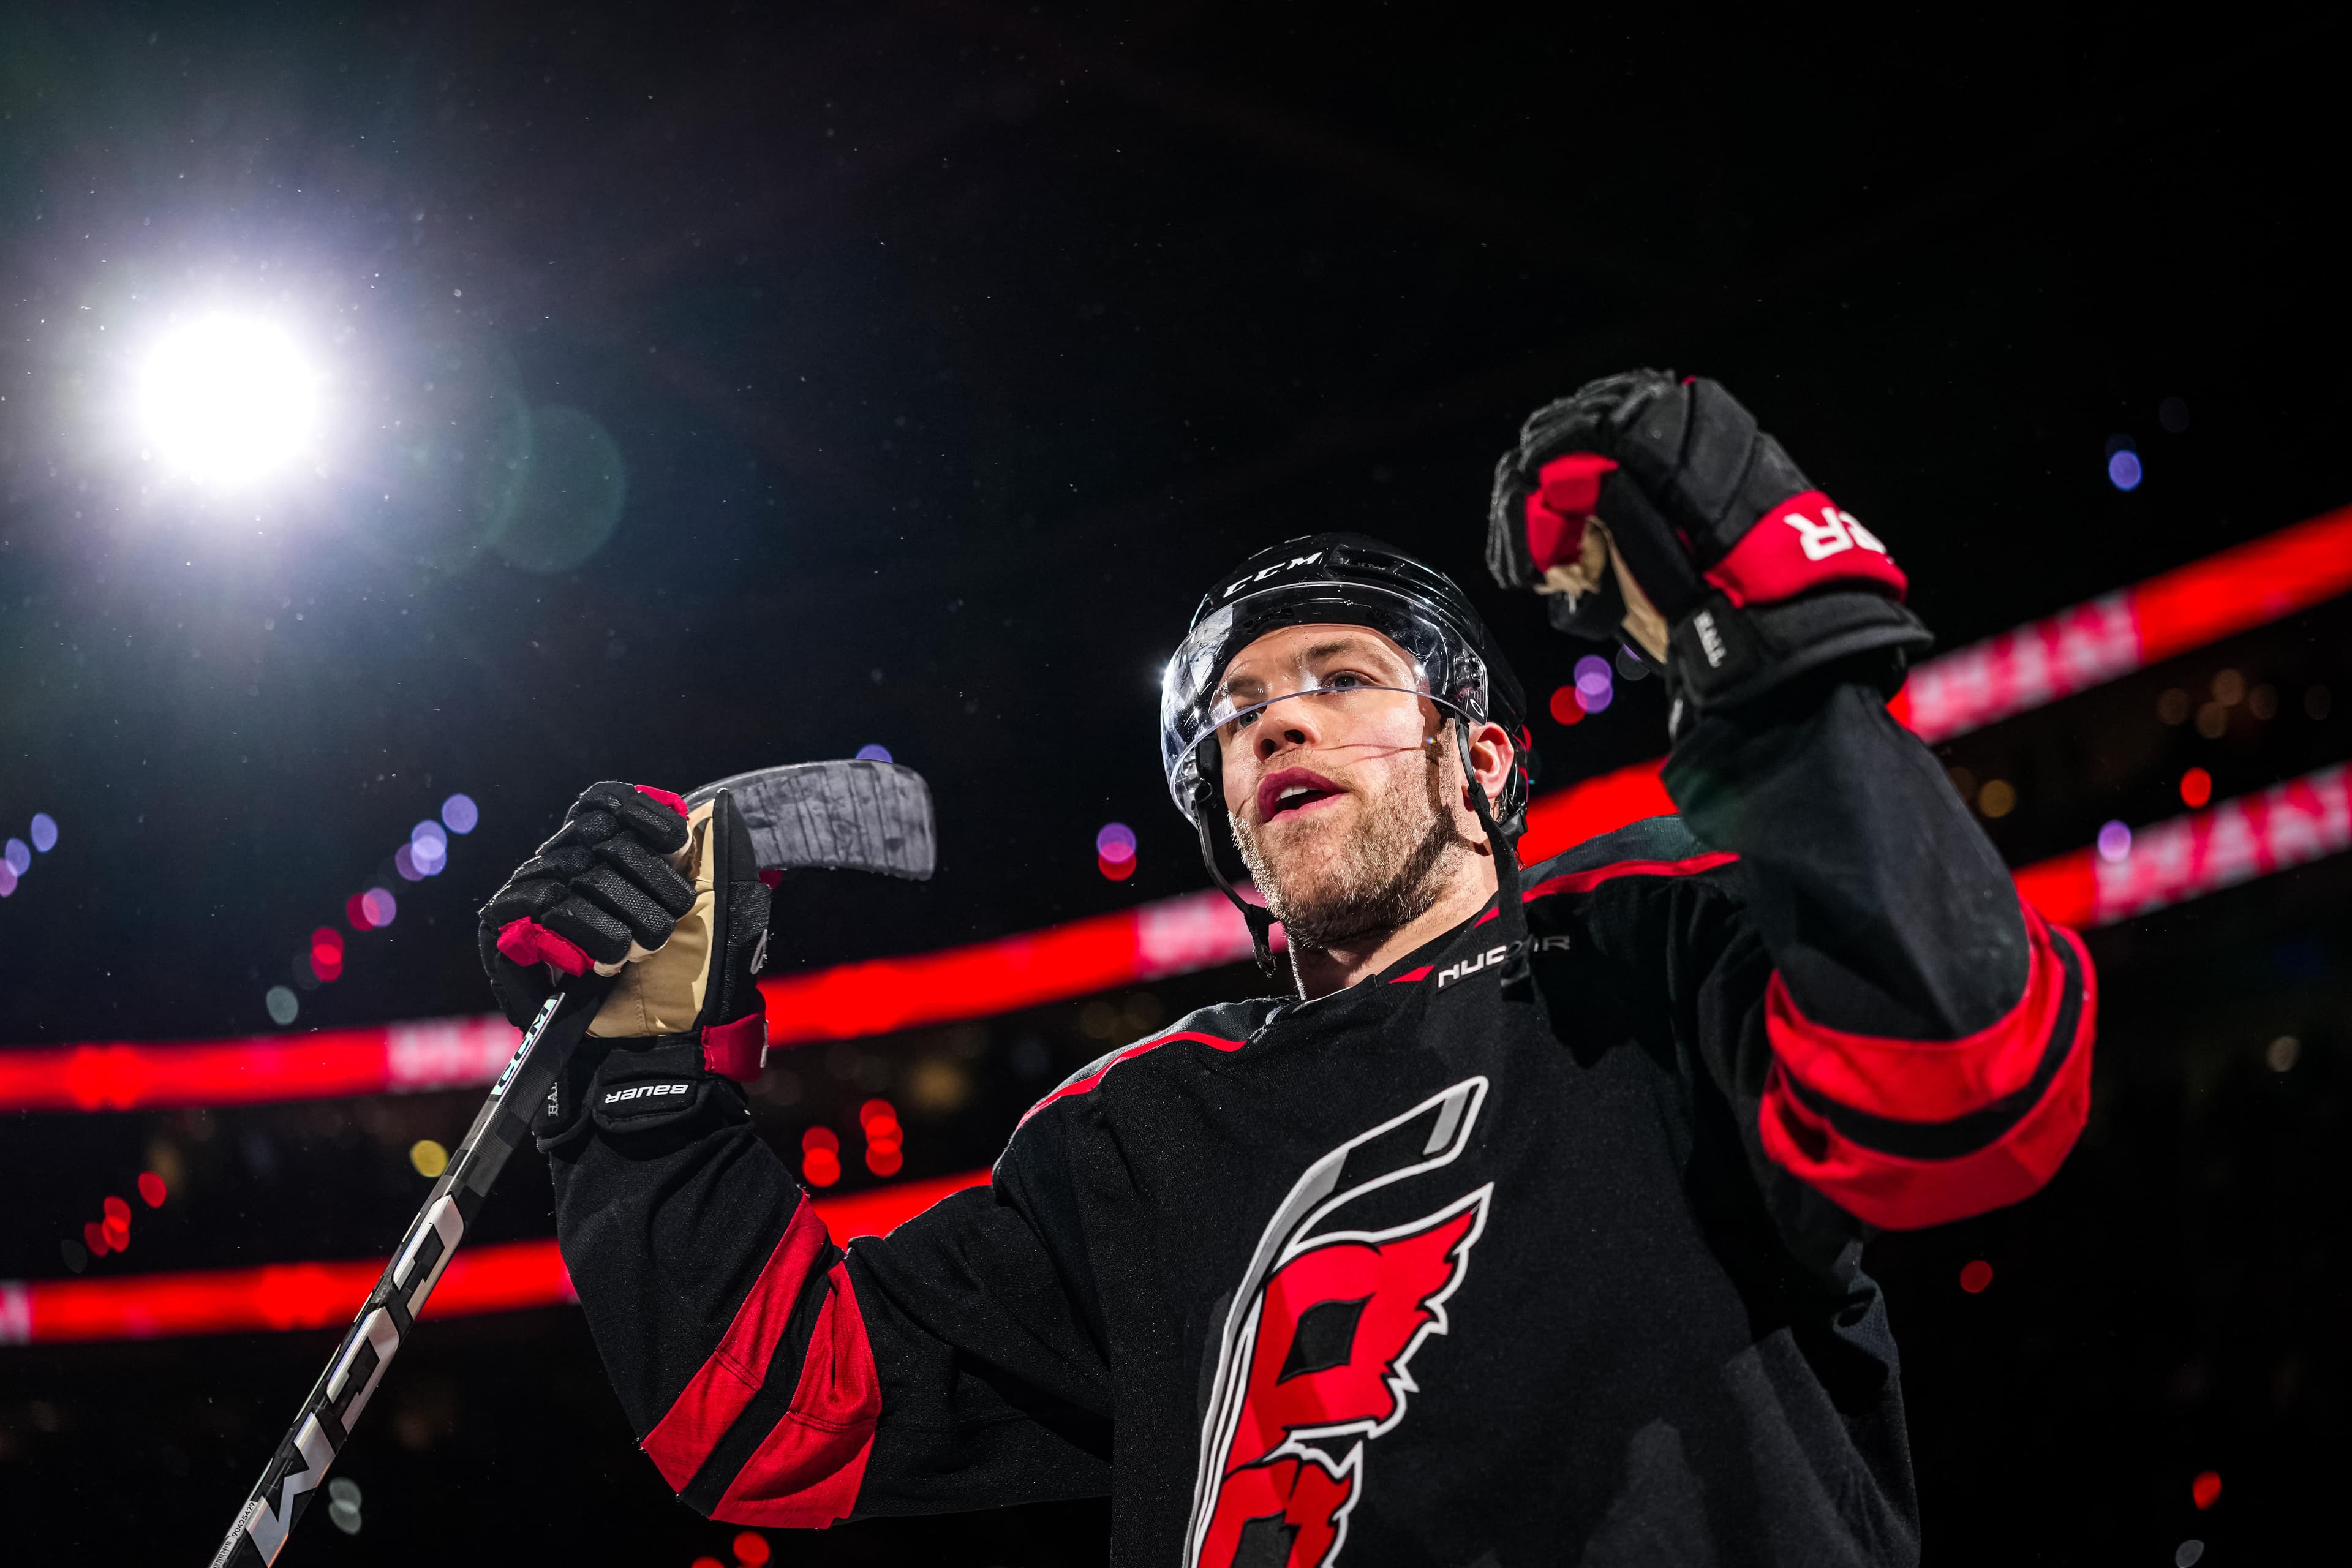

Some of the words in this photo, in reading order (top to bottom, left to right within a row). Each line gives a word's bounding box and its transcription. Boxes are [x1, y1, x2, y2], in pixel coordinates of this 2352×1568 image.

[1223, 551, 1323, 598] CCM
[1438, 935, 1571, 989] NUCR
[497, 1006, 549, 1088] CCM
[604, 1084, 689, 1104] BAUER
[246, 1194, 465, 1568] CCM
[232, 1501, 256, 1538] 90425429
